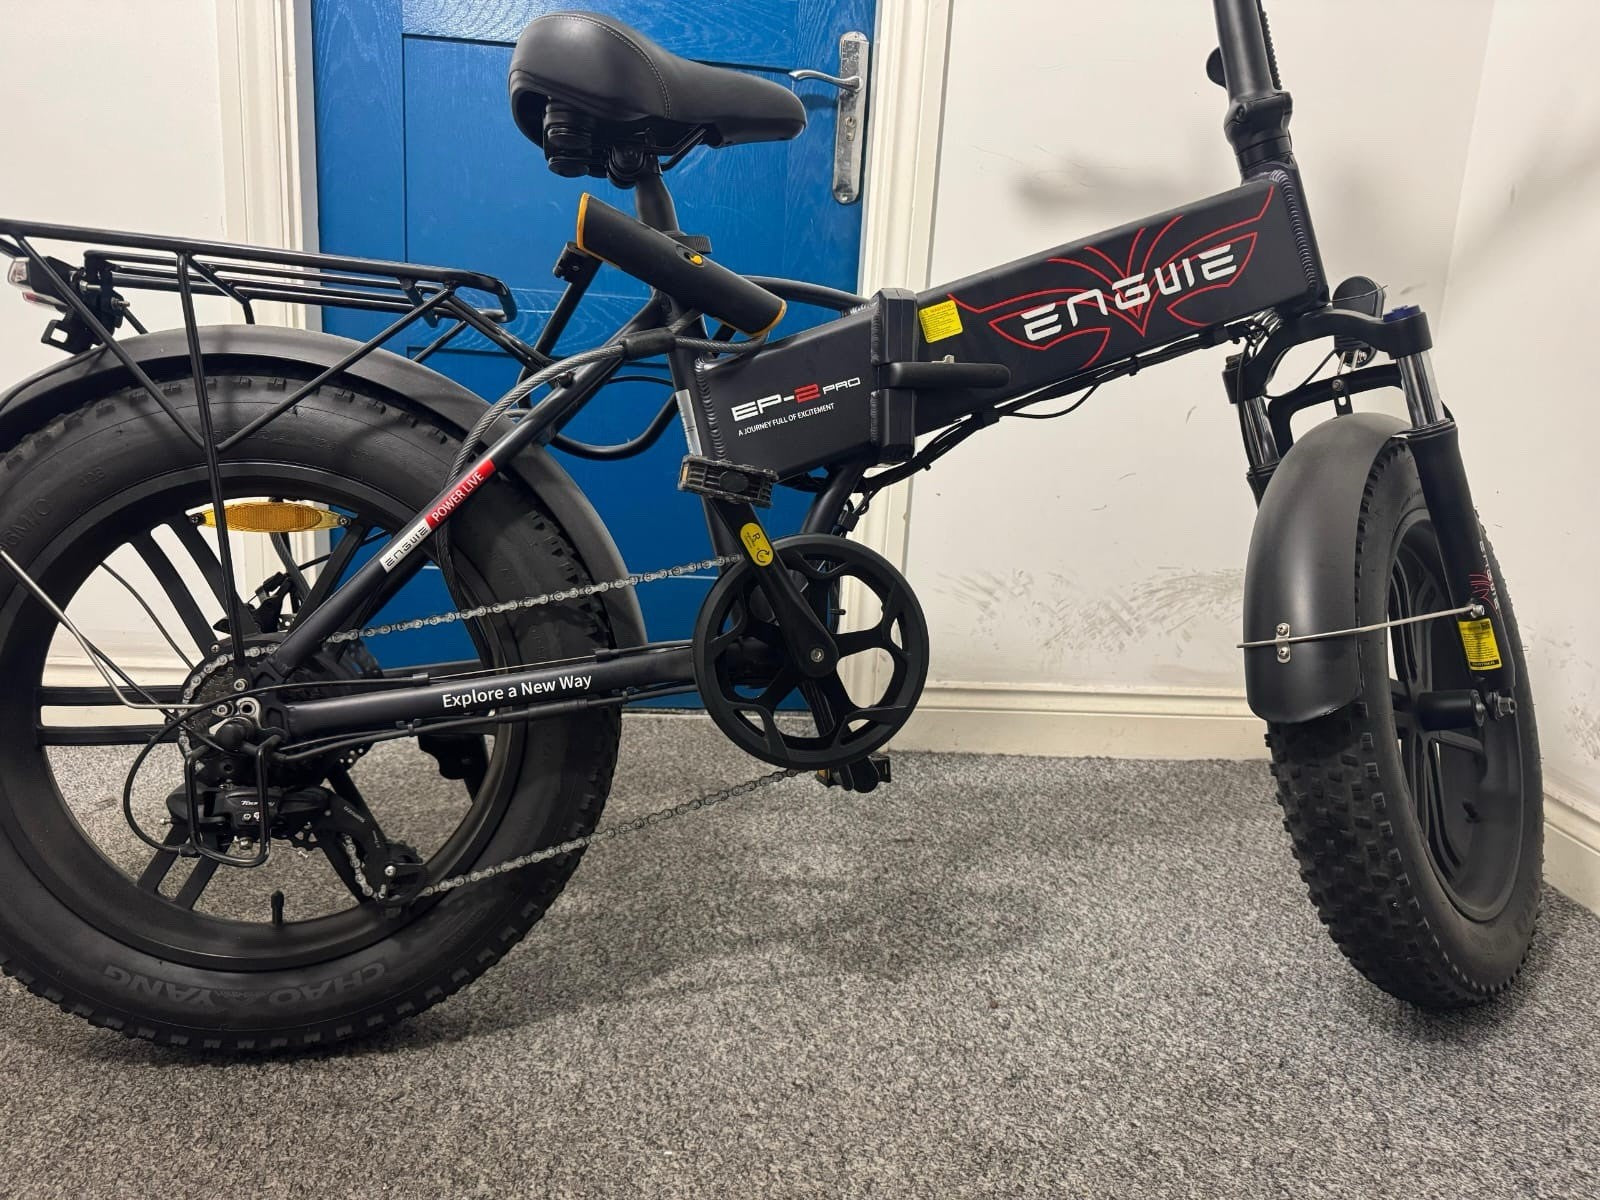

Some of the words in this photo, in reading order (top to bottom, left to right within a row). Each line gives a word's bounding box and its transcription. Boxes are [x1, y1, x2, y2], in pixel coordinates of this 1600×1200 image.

[731, 383, 821, 422] EP-2
[822, 377, 861, 395] PRO
[744, 420, 772, 435] JOURNEY
[772, 416, 788, 427] FULL
[788, 413, 797, 422] OF
[797, 402, 835, 419] EXCITEMENT
[431, 490, 466, 522] POWER
[462, 471, 485, 493] LIVE
[442, 688, 504, 708] Explore
[508, 686, 517, 698] a
[521, 680, 556, 696] New
[558, 674, 592, 691] Way
[104, 964, 215, 1007] YANG
[268, 961, 386, 1005] CHAO
